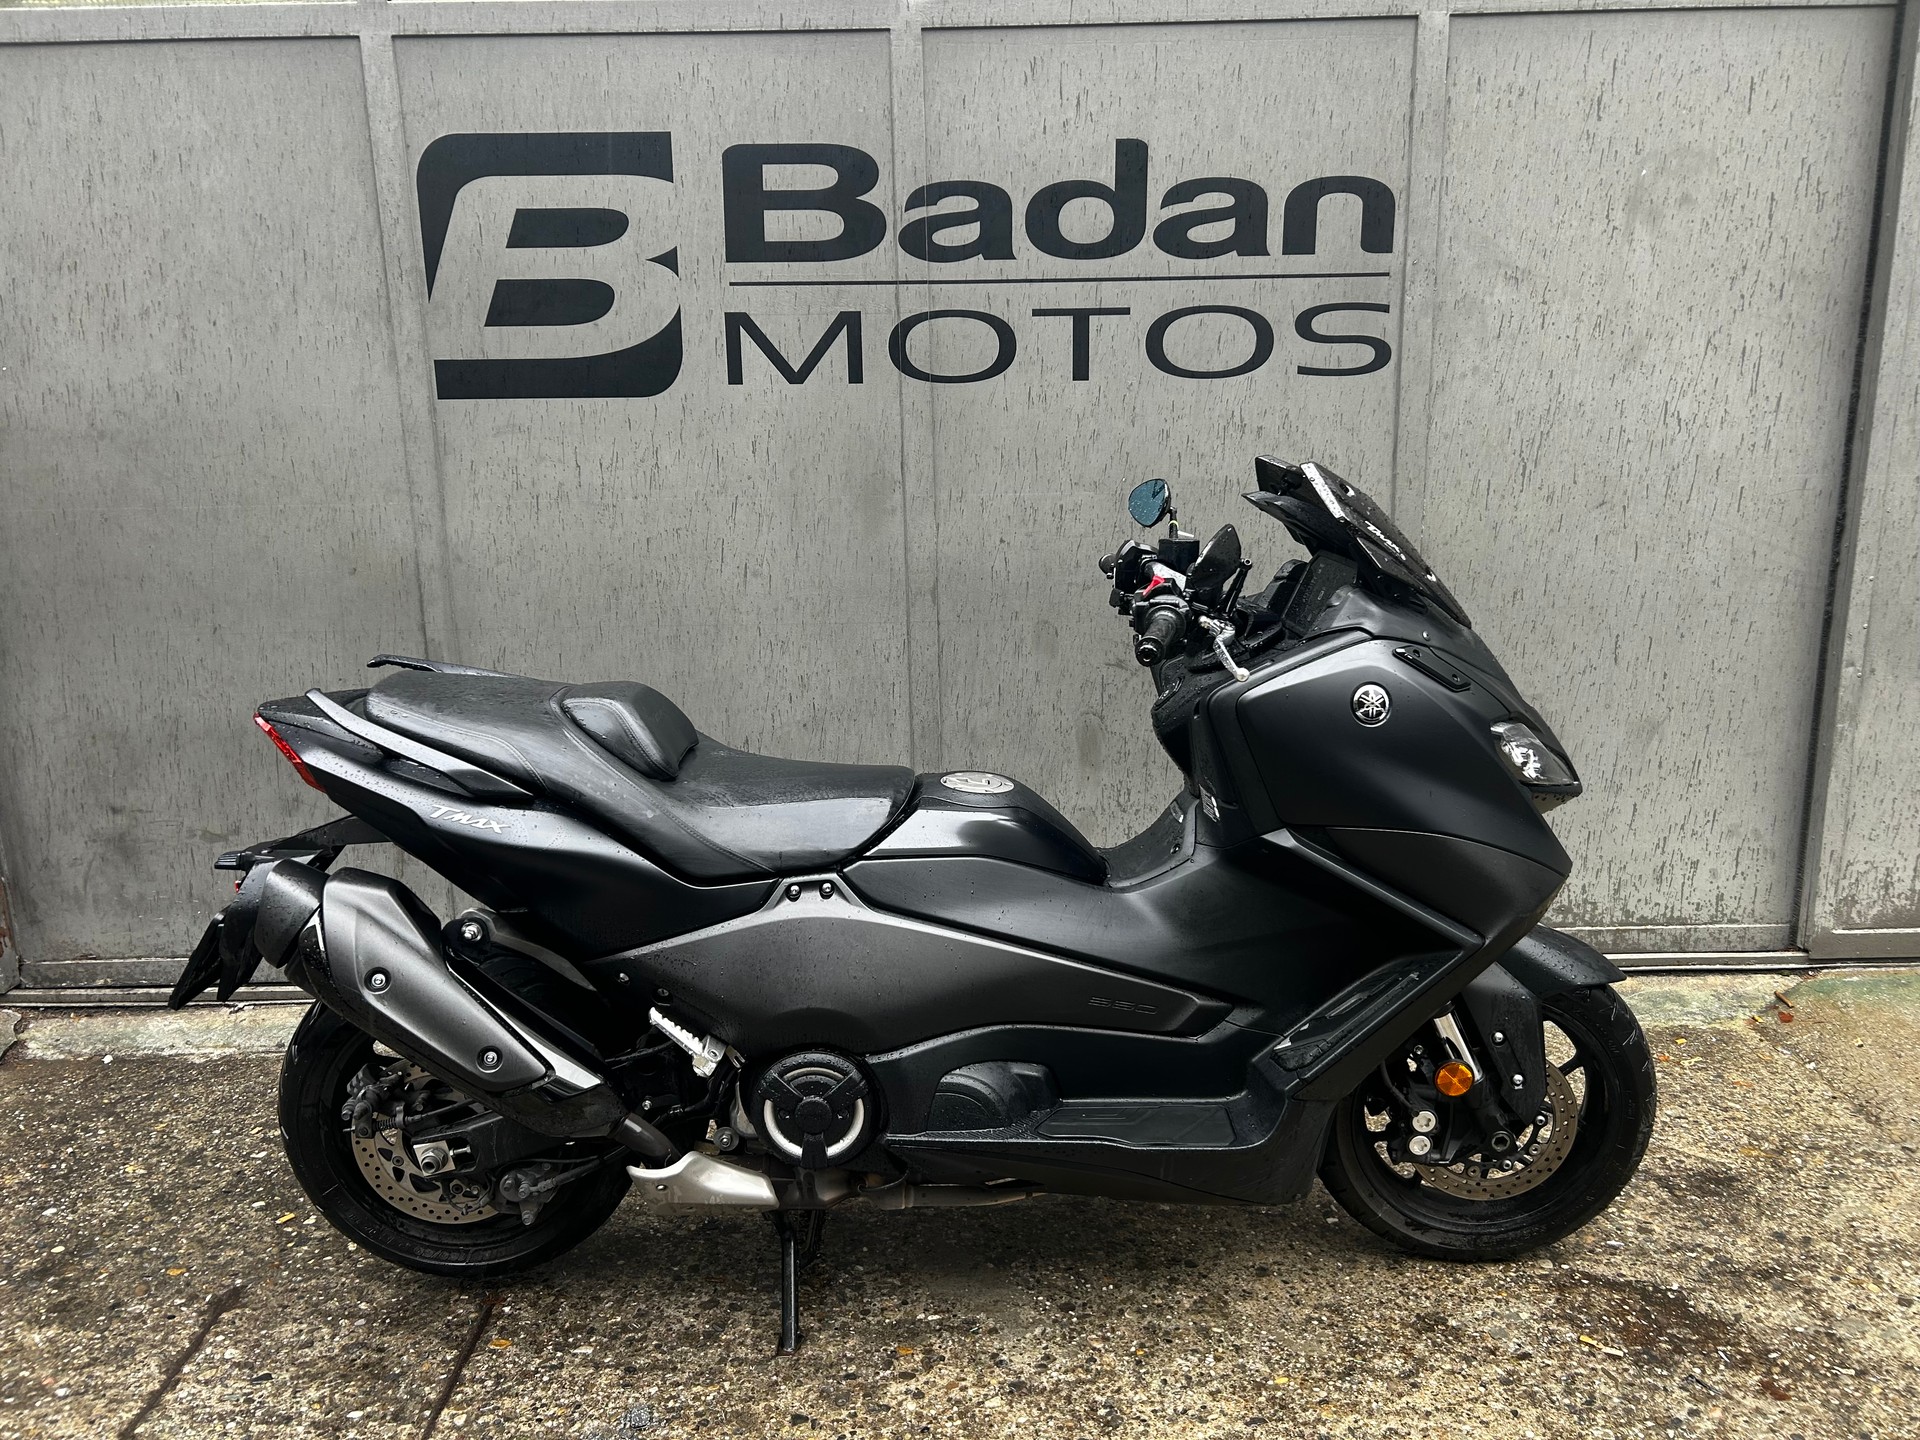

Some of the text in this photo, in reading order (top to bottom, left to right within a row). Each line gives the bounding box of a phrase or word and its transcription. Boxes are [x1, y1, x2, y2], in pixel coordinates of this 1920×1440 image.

[722, 138, 1396, 263] Badan
[724, 302, 1393, 386] MOTOS
[429, 804, 511, 834] TMAX
